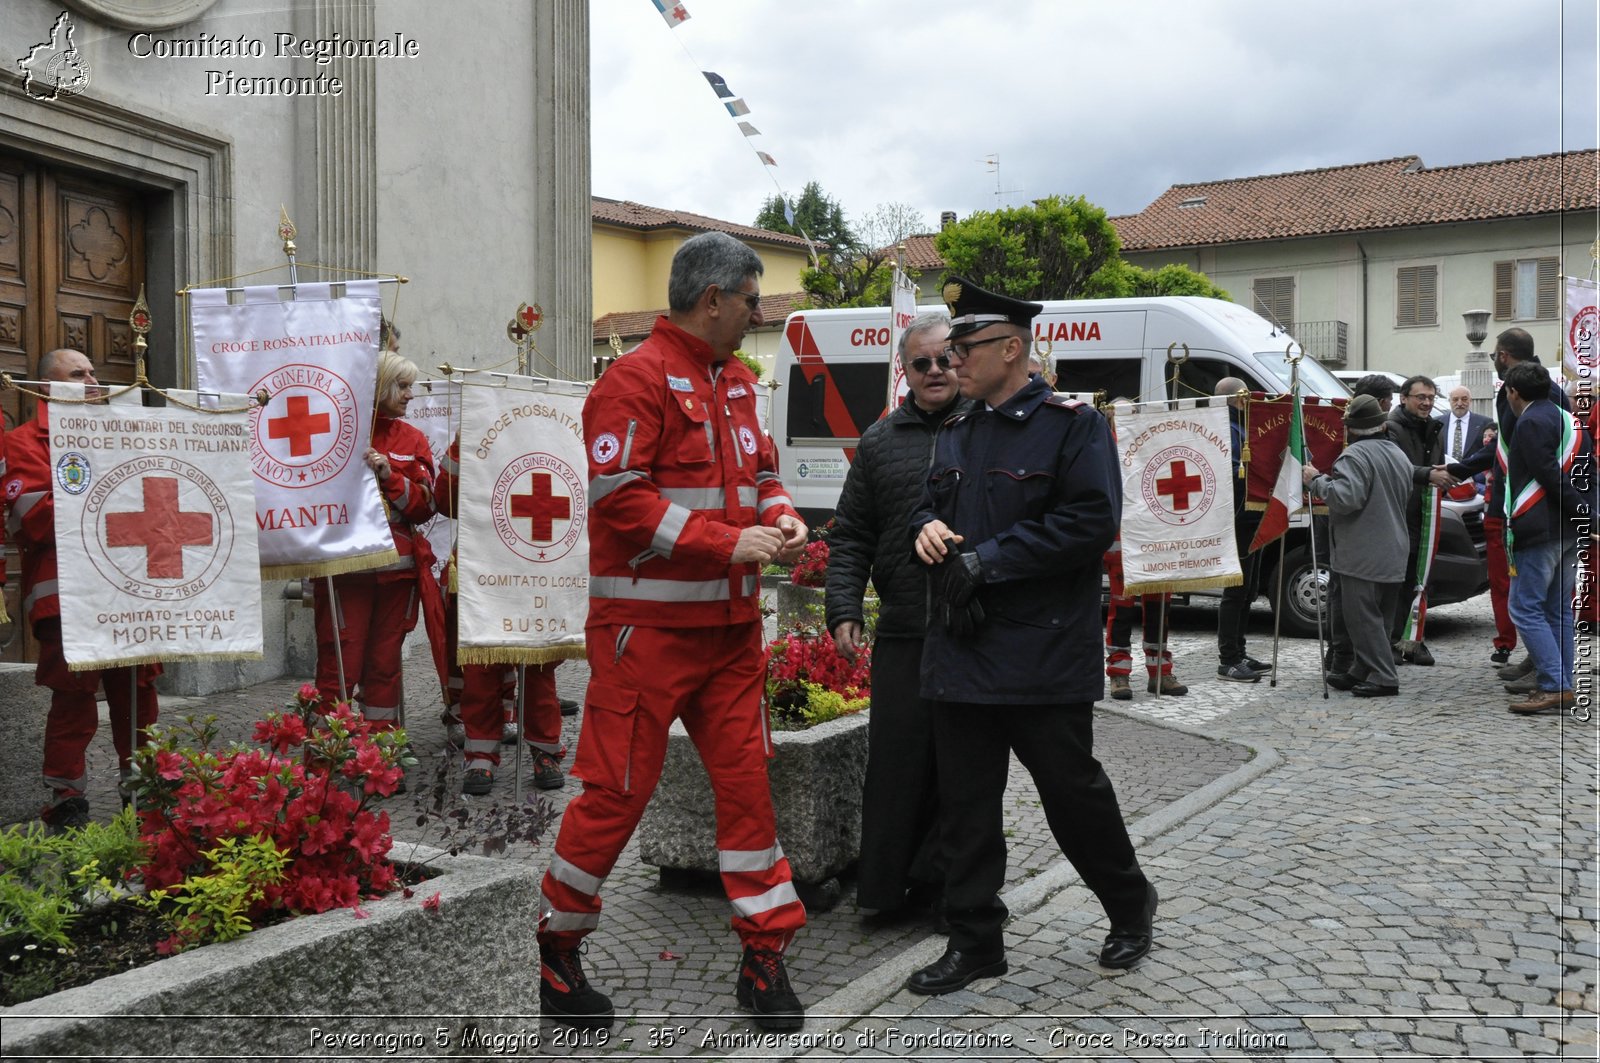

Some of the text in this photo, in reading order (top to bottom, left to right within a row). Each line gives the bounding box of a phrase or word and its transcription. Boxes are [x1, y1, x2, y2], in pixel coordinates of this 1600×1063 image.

[212, 332, 372, 354] CROCE ROSSA ITALIANA
[850, 322, 1102, 346] CRO LIANA
[272, 369, 333, 392] GINEVRA
[333, 388, 350, 404] 22
[60, 417, 242, 436] CORPO VOLONTARI DEL SOCCORSO
[334, 406, 354, 459] AGOSTO
[476, 404, 585, 460] CROCE ROSSA ITAL
[1289, 412, 1338, 441] CMUNALE
[53, 434, 249, 453] CROCE ROSSA ITALIANA
[1123, 420, 1229, 467] CROCE ROSSA ITALIANA
[311, 456, 338, 480] 1864
[87, 458, 164, 513] CONVENZIONE
[170, 459, 183, 472] DI
[186, 467, 226, 513] GINEVRA
[1144, 463, 1163, 516] CONVENZIONE
[1155, 456, 1163, 464] DI
[1162, 448, 1193, 460] GINEVRA
[1193, 454, 1203, 464] 22
[1201, 463, 1214, 496] AGOSTO
[494, 457, 584, 547] CONVENZIONE DI GINEVRA 22 AGOSTO 1864
[256, 504, 349, 531] MANTA
[1141, 538, 1222, 553] COMITATO LOCALE
[1143, 557, 1222, 572] LIMONE PIEMONTE
[478, 574, 587, 588] COMITATO LOCALE
[534, 596, 548, 609] DI
[113, 624, 222, 645] MORETTA
[503, 618, 567, 632] BUSCA
